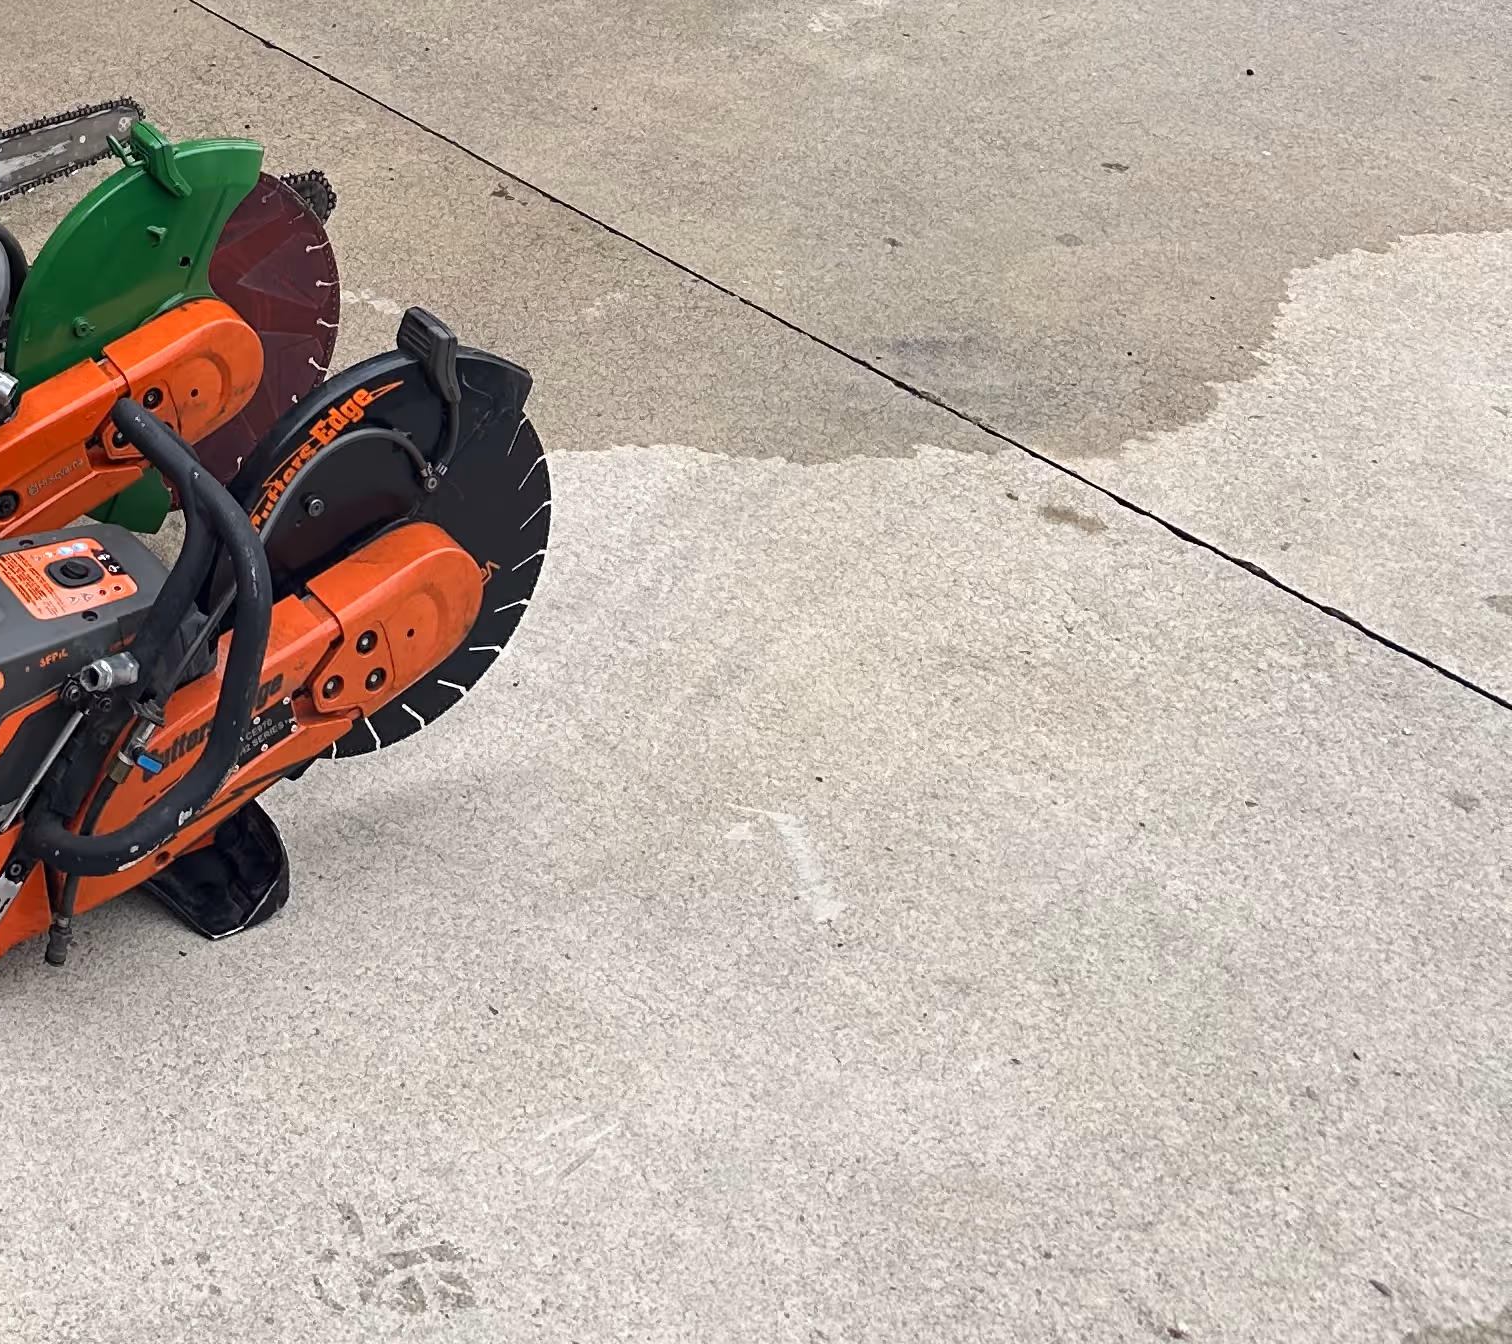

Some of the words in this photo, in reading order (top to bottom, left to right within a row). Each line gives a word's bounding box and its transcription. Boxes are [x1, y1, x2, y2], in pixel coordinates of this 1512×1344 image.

[309, 388, 373, 445] Edge
[245, 718, 273, 741] CE970
[252, 721, 285, 747] SERIES
